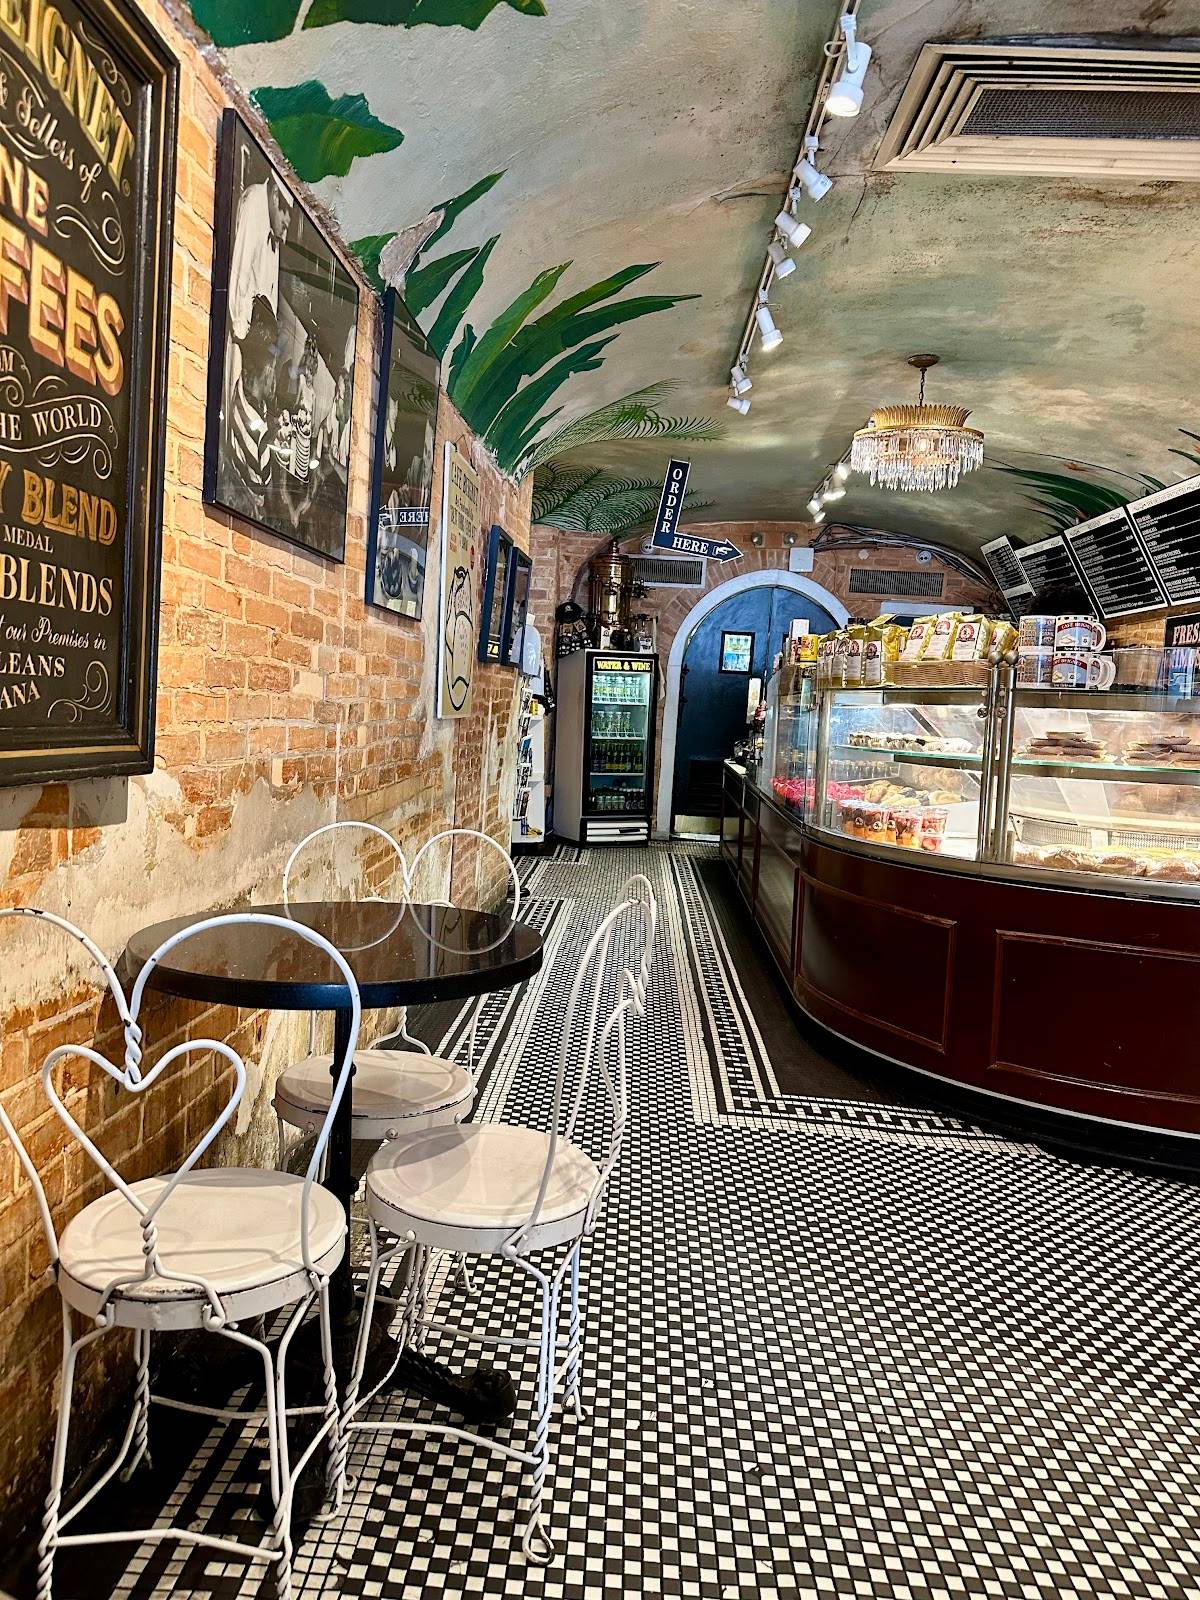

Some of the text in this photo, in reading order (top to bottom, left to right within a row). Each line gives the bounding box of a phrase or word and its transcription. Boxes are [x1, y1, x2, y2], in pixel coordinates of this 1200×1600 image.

[16, 86, 75, 171] Sellers
[79, 162, 102, 204] of
[32, 403, 102, 437] WORLD
[21, 469, 117, 546] BLEND
[660, 468, 683, 534] ORDER
[3, 524, 54, 554] MEDAL
[672, 536, 709, 555] HERE
[0, 552, 113, 616] BLENDS
[6, 623, 27, 641] our
[31, 615, 89, 649] Premises
[93, 632, 107, 651] in
[1171, 622, 1200, 648] FRES
[596, 661, 622, 670] WATER
[631, 661, 651, 671] WINE
